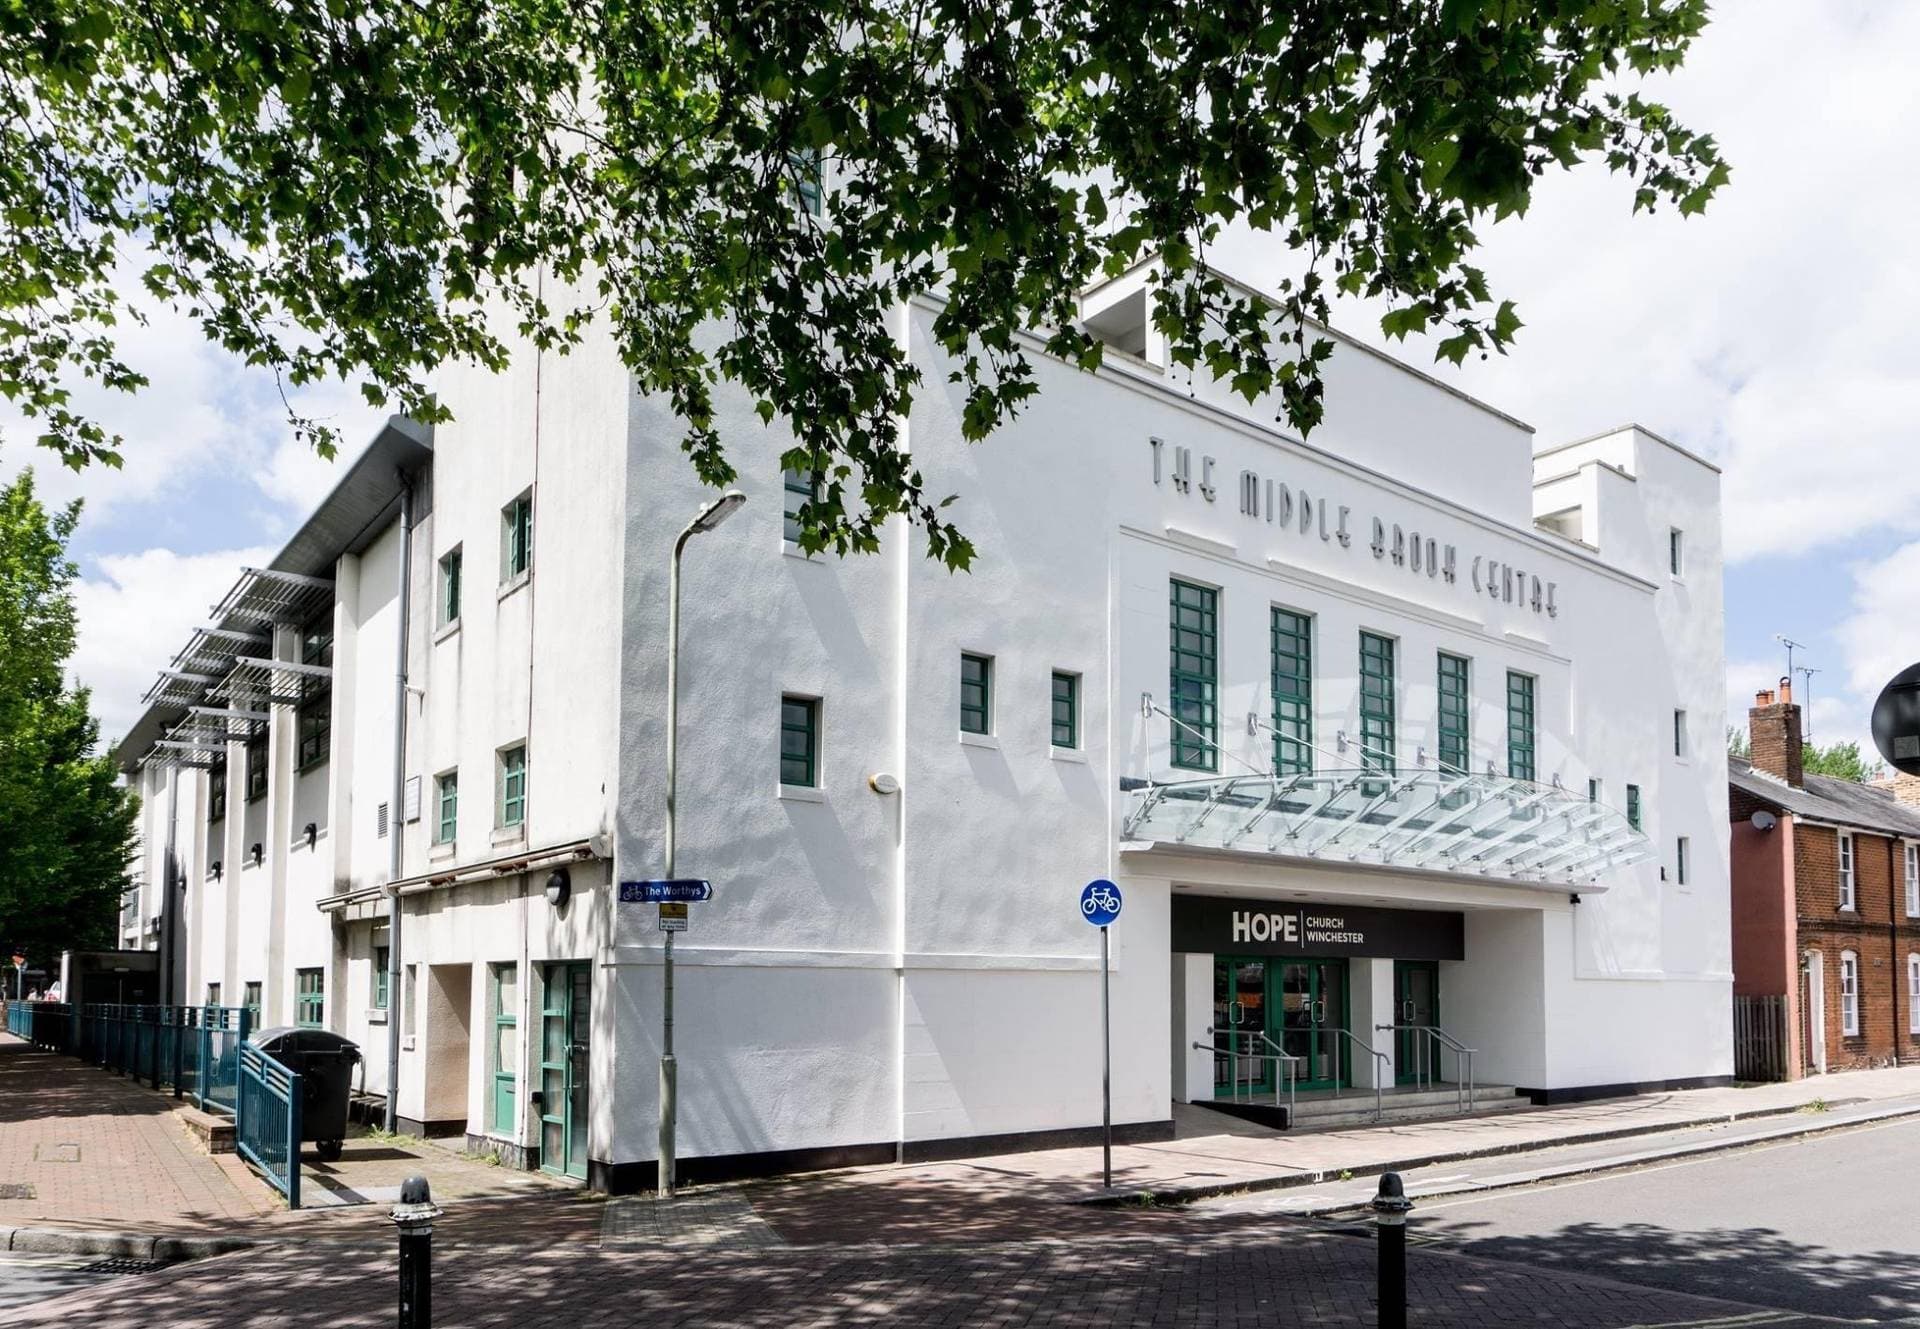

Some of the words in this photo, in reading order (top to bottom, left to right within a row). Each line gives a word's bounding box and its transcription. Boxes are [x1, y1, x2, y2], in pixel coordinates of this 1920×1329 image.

[1149, 436, 1217, 502] THE
[1239, 469, 1352, 548] MIDDLE
[1369, 516, 1457, 584] BROOK
[1472, 555, 1559, 619] CENTRE
[645, 887, 660, 896] The
[663, 886, 701, 897] Worthys
[1232, 911, 1298, 942] HOPE
[1306, 916, 1344, 929] CHURCH
[1306, 931, 1364, 944] WINCHESTER
